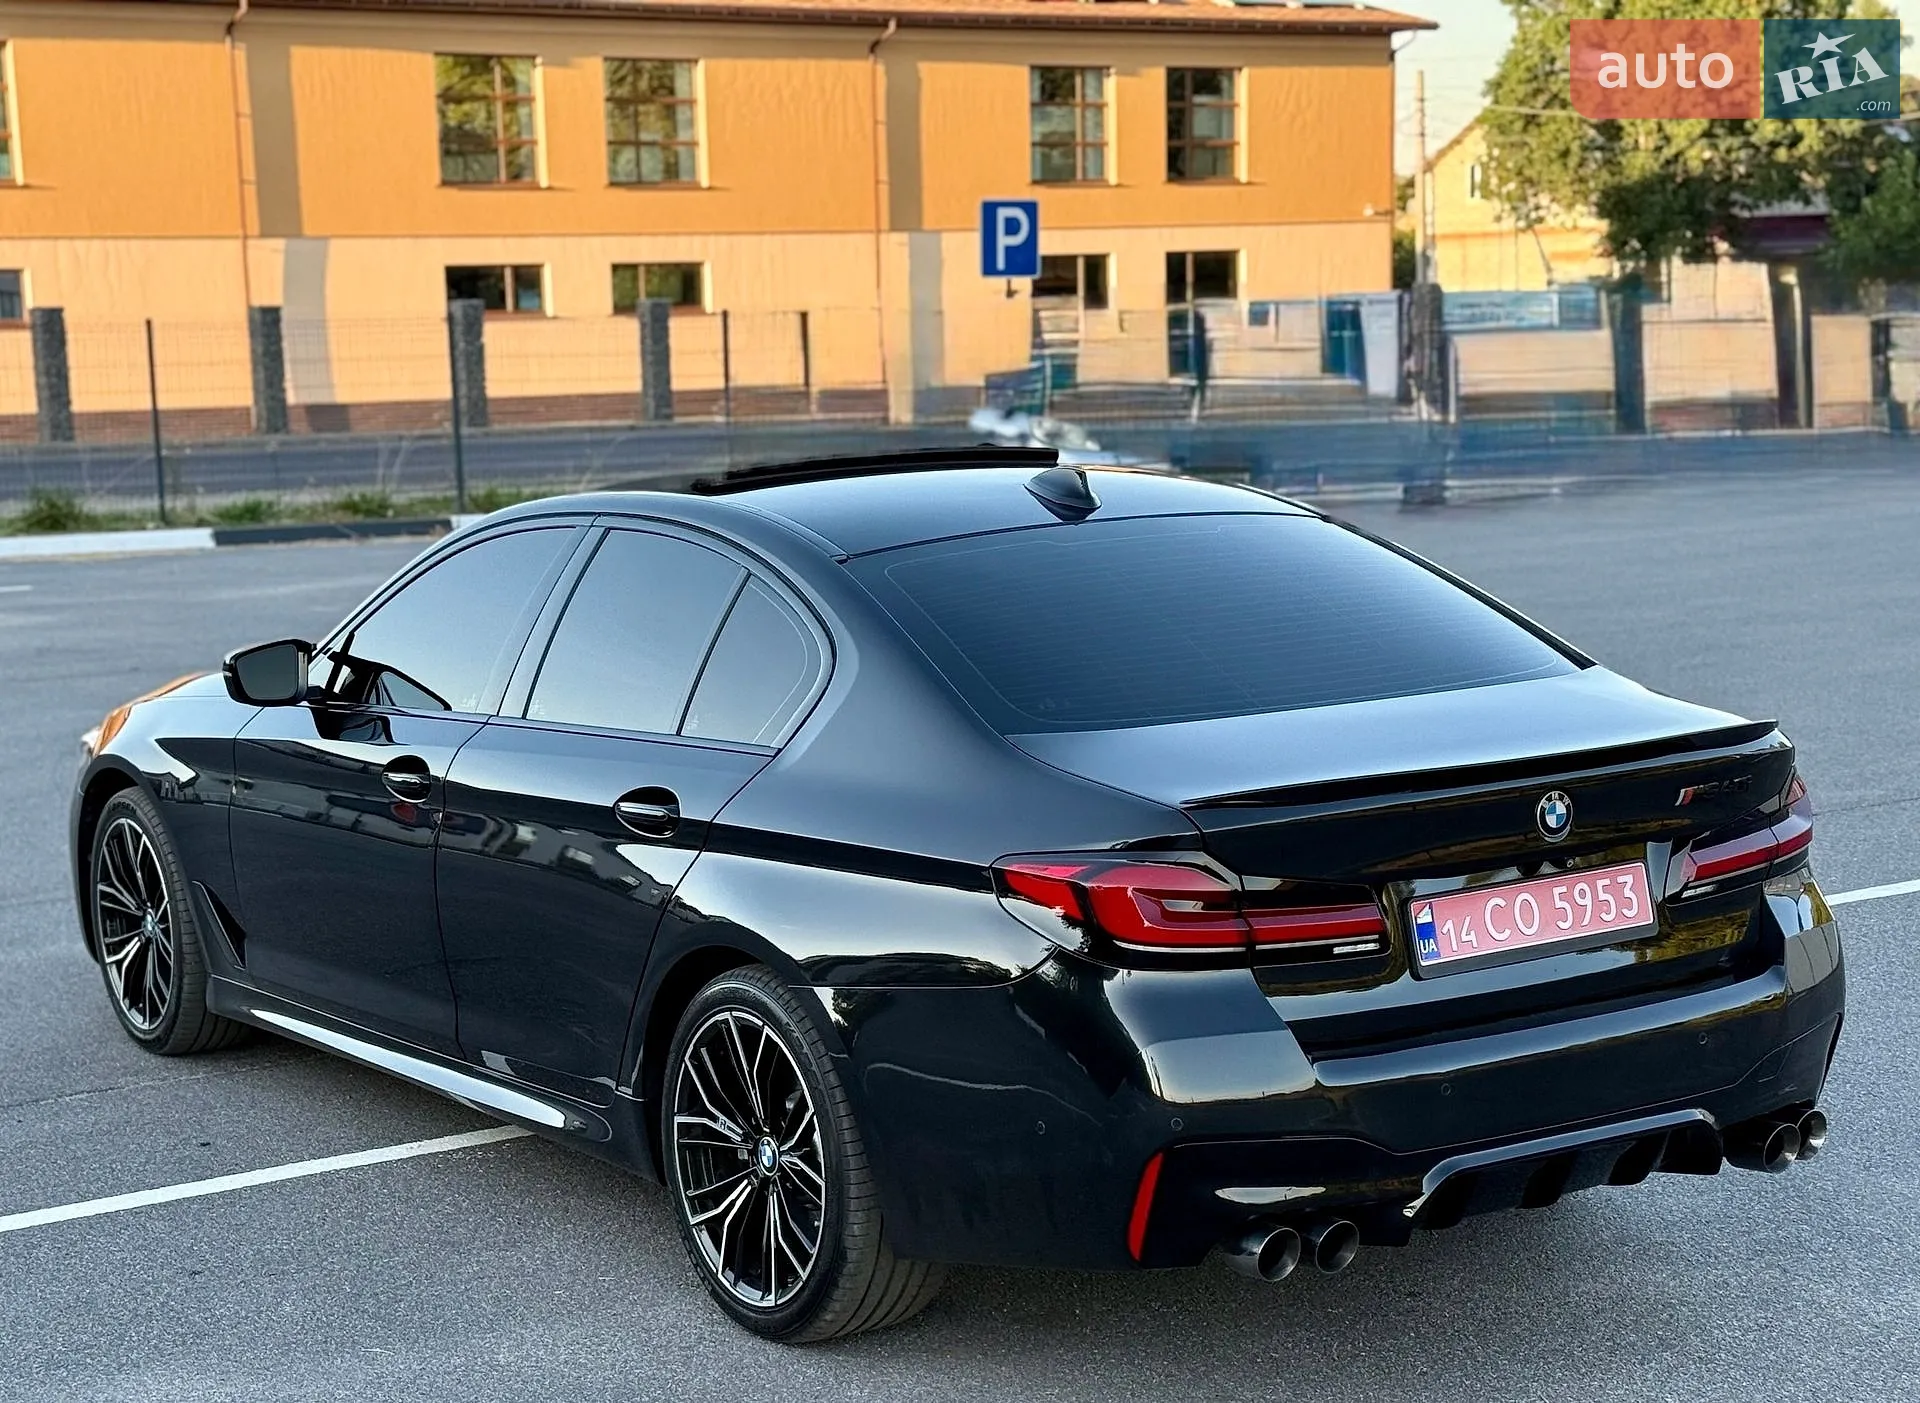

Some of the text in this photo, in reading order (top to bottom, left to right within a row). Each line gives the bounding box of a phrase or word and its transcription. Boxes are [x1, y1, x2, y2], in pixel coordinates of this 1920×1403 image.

[996, 206, 1030, 271] P
[1441, 874, 1639, 952] 14 CO 5953
[1420, 938, 1437, 954] UA
